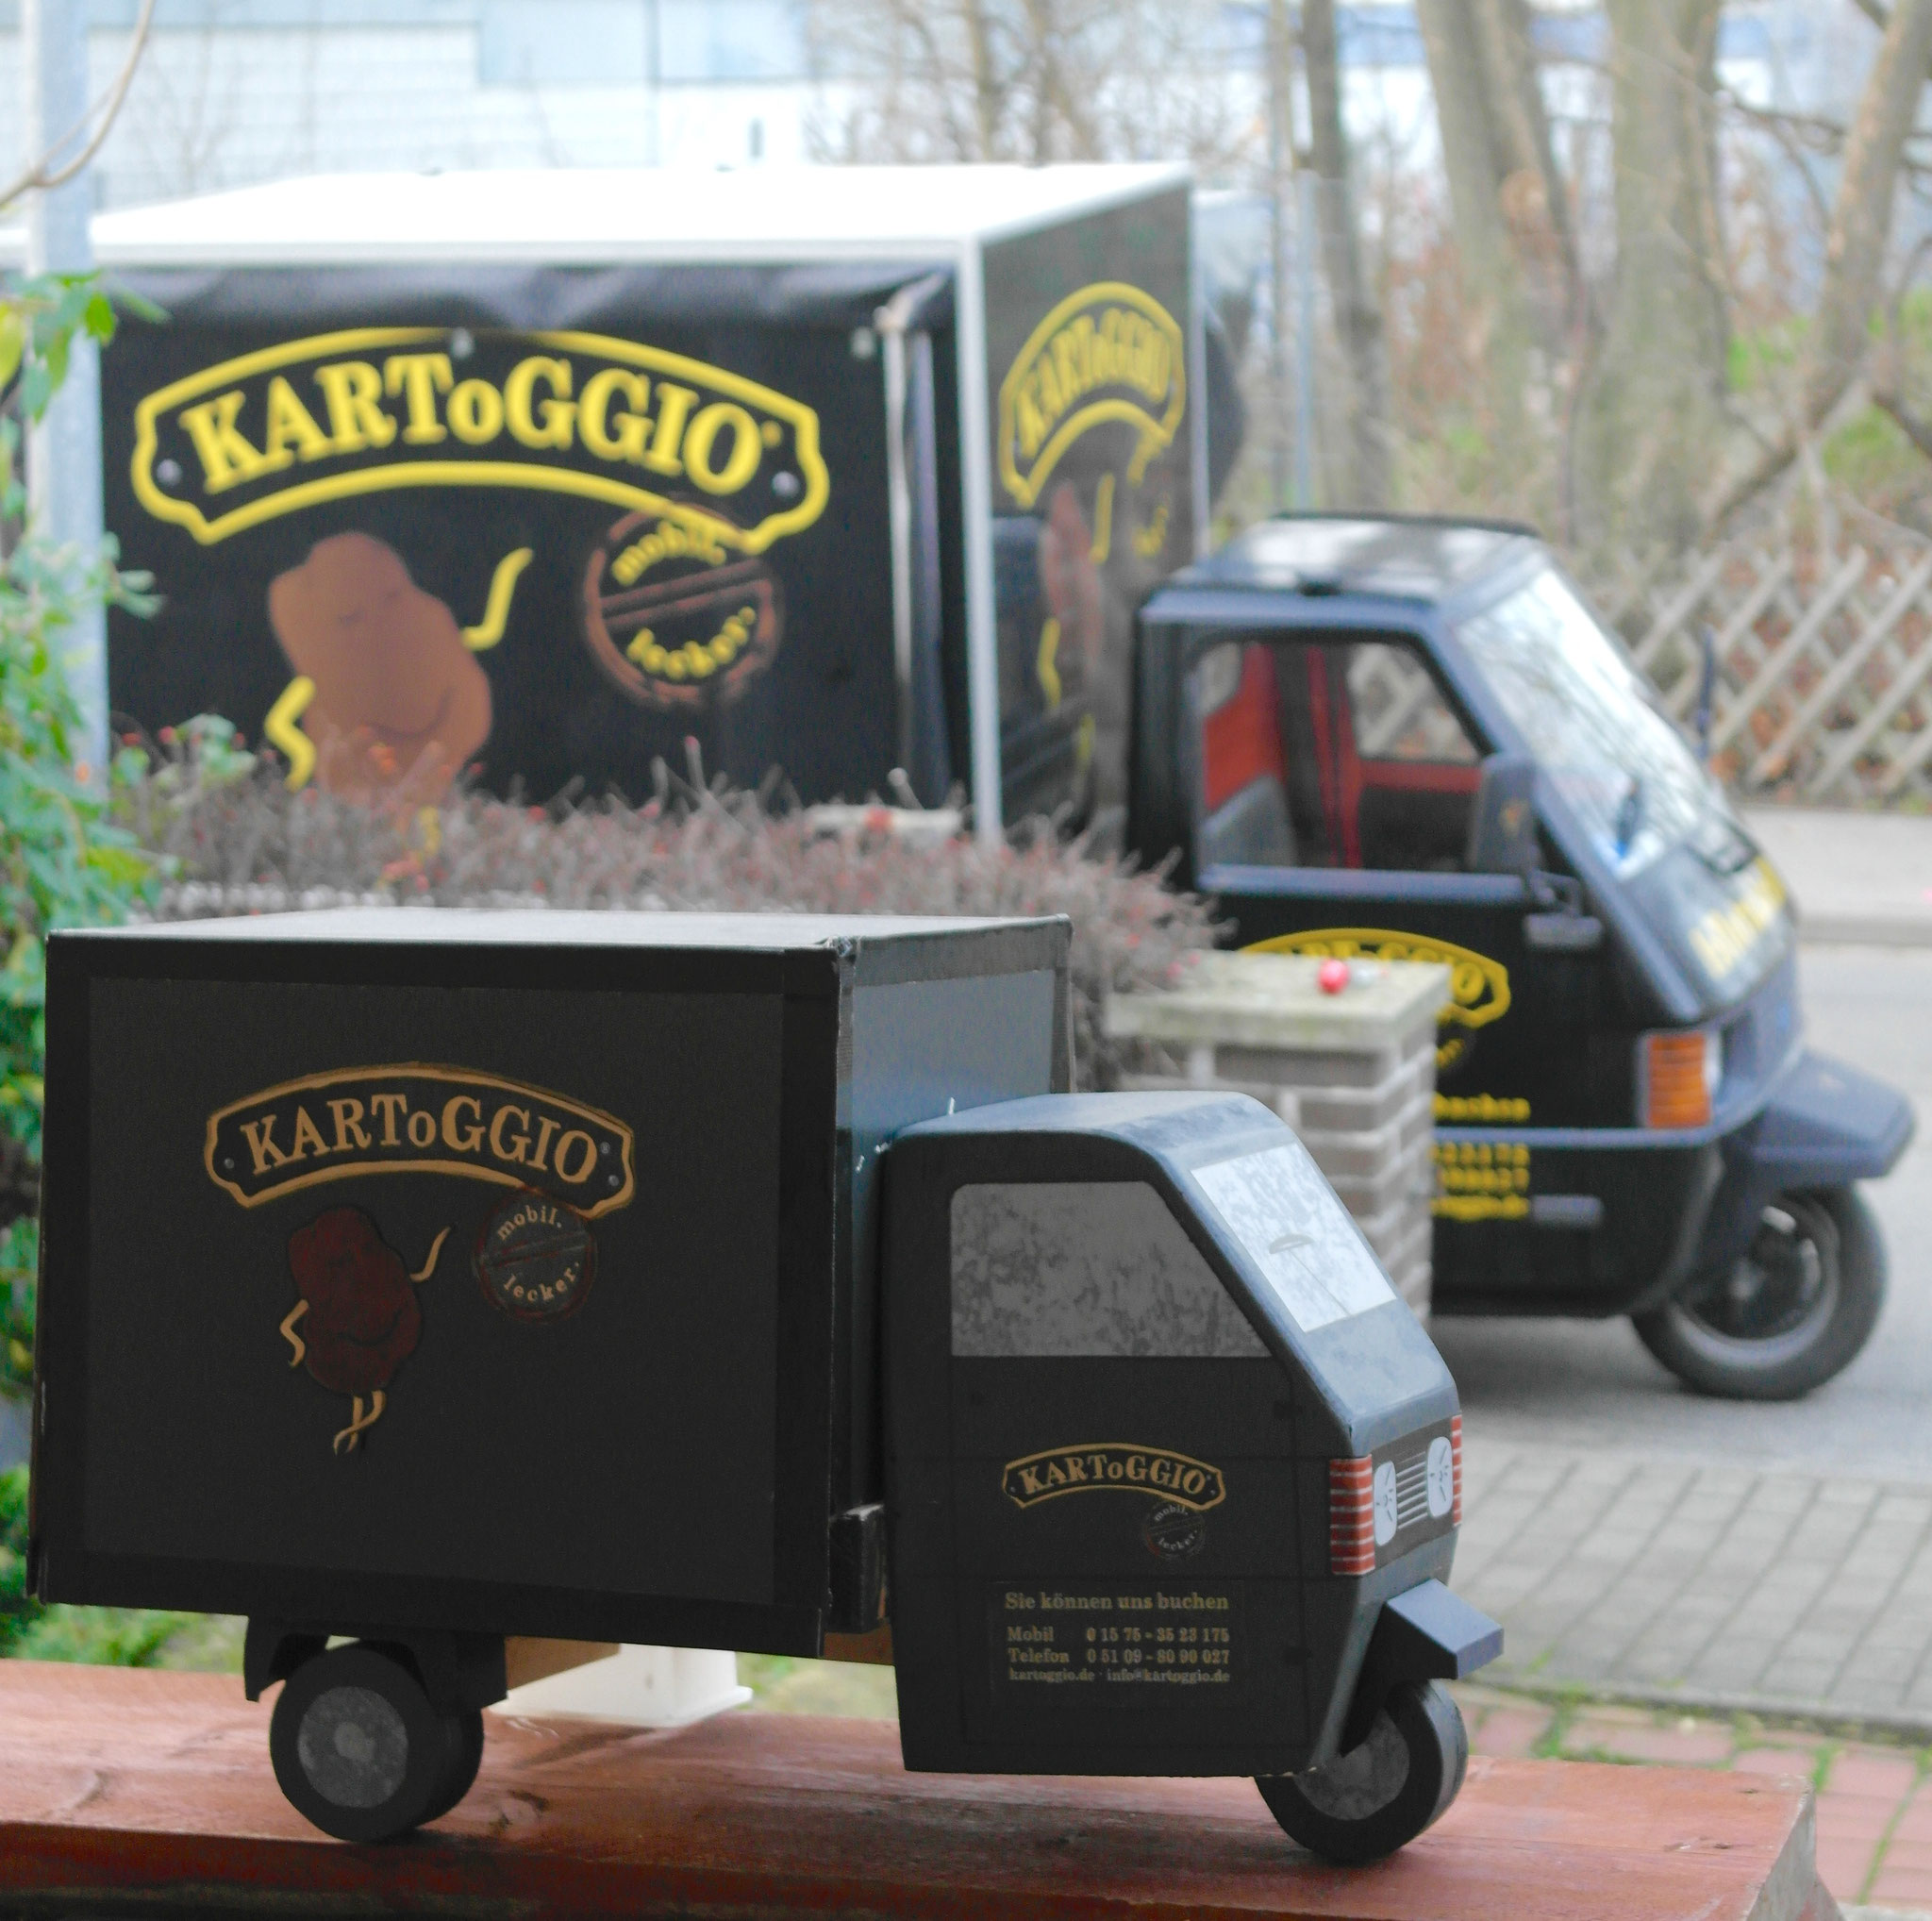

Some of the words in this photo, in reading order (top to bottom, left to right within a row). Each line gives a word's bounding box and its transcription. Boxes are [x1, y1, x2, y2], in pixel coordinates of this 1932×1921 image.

[240, 1094, 597, 1183] KARToGGIO
[497, 1205, 562, 1241] mobil.
[1018, 1454, 1207, 1495] KARToGGIO
[1004, 1592, 1036, 1610] Sie
[1041, 1591, 1113, 1610] können
[1117, 1596, 1154, 1610] uns
[1157, 1592, 1230, 1610] buchen
[1007, 1626, 1055, 1643] Mobil
[1008, 1647, 1070, 1663] Telefon
[1008, 1667, 1095, 1683] kartoggio.de
